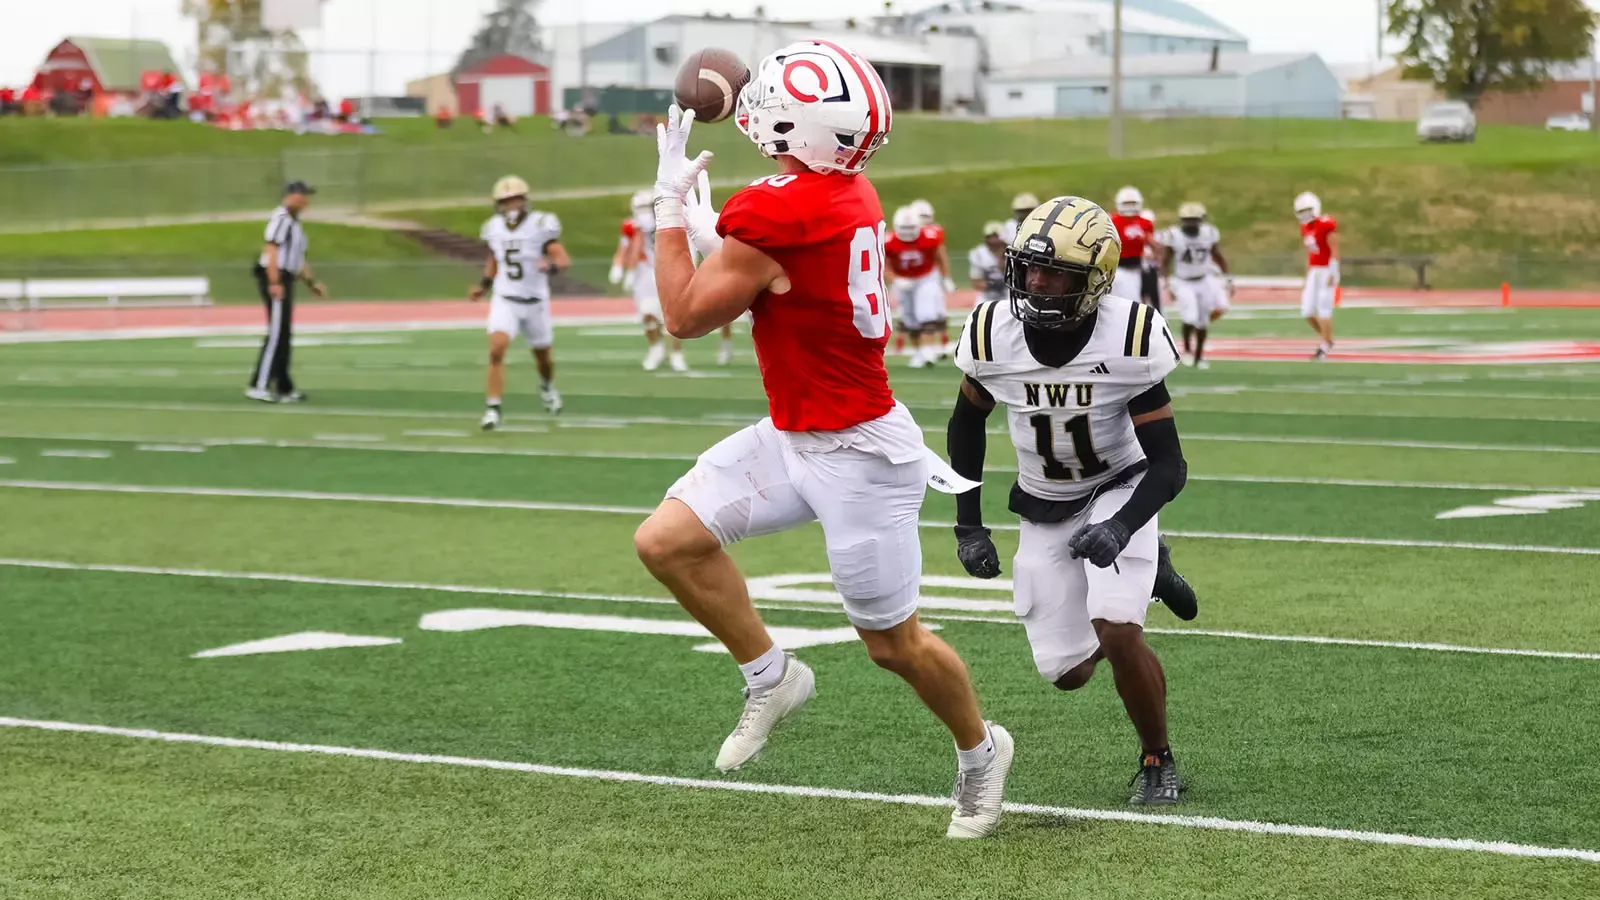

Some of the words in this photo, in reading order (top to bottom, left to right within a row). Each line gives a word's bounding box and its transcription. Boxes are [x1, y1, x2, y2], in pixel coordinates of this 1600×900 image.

[504, 248, 524, 281] 5
[1023, 383, 1094, 408] NWU
[1029, 411, 1112, 482] 11
